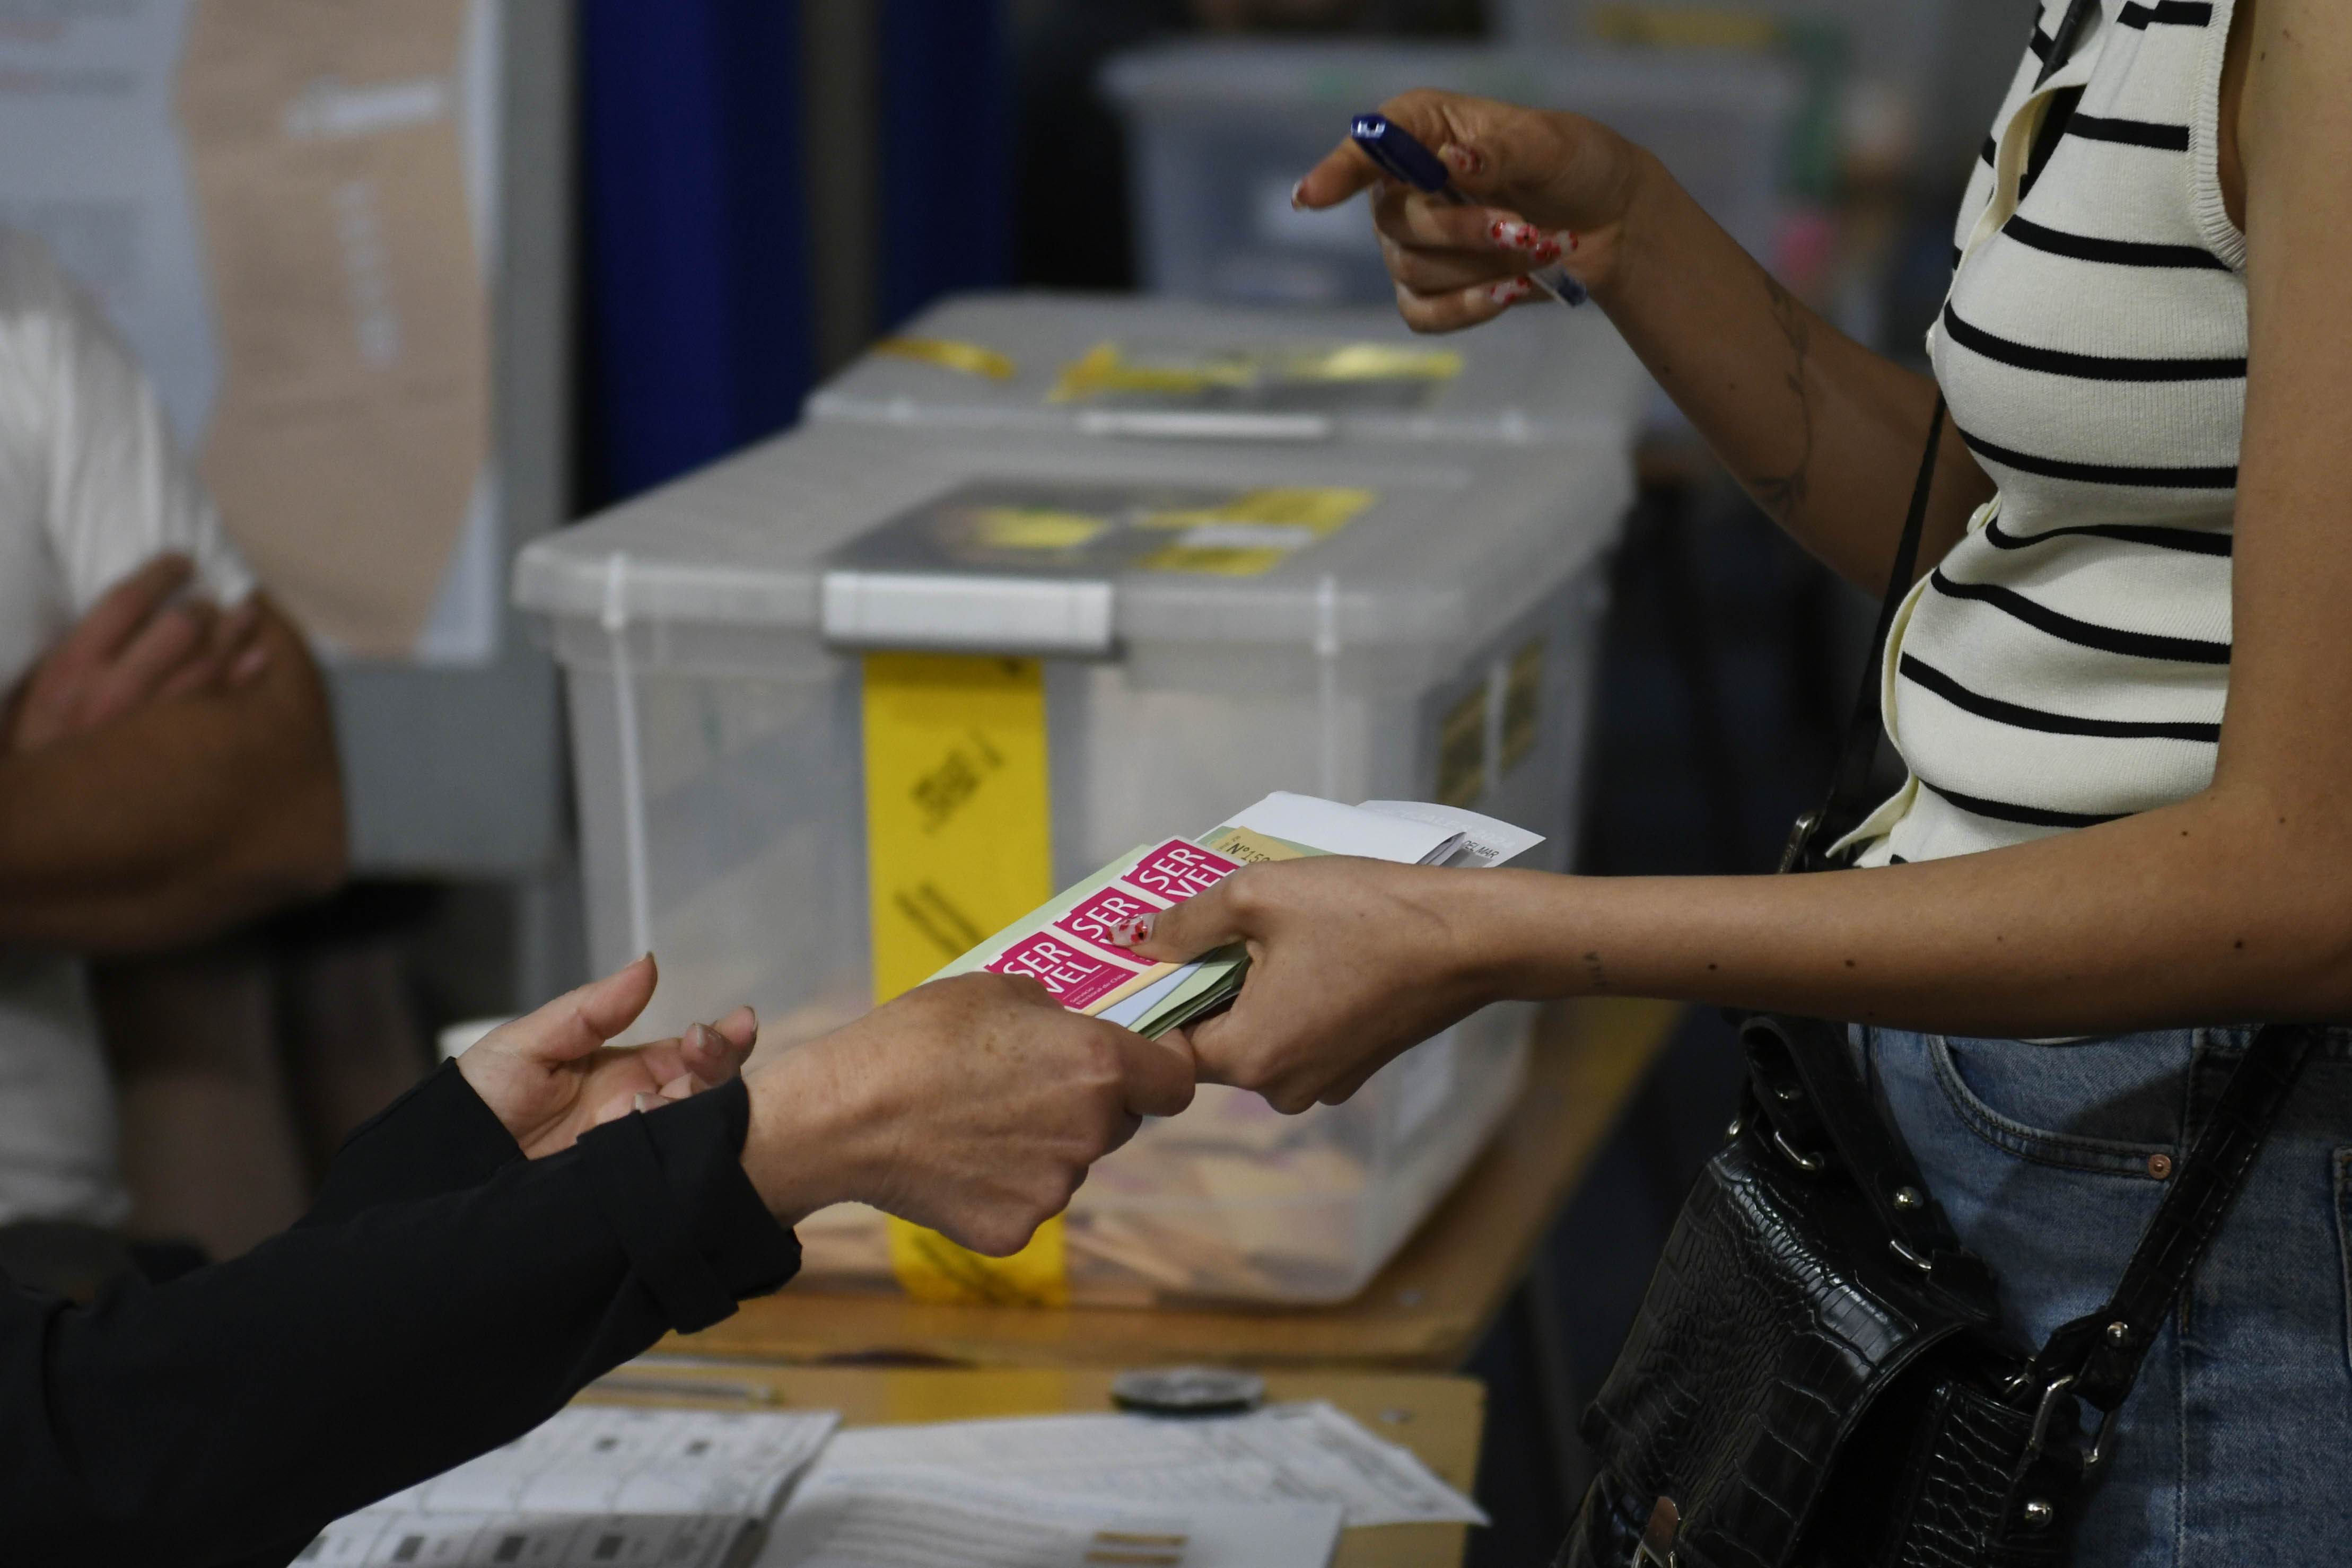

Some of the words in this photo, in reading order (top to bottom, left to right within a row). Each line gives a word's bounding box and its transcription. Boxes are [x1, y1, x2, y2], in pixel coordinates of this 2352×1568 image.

[1464, 840, 1480, 852] DEL
[1476, 846, 1499, 859] MAR
[1139, 848, 1206, 891] SER
[1165, 864, 1236, 897] VEL
[1072, 897, 1140, 939] SER
[1003, 942, 1073, 978] SER
[1043, 961, 1102, 993] VEL
